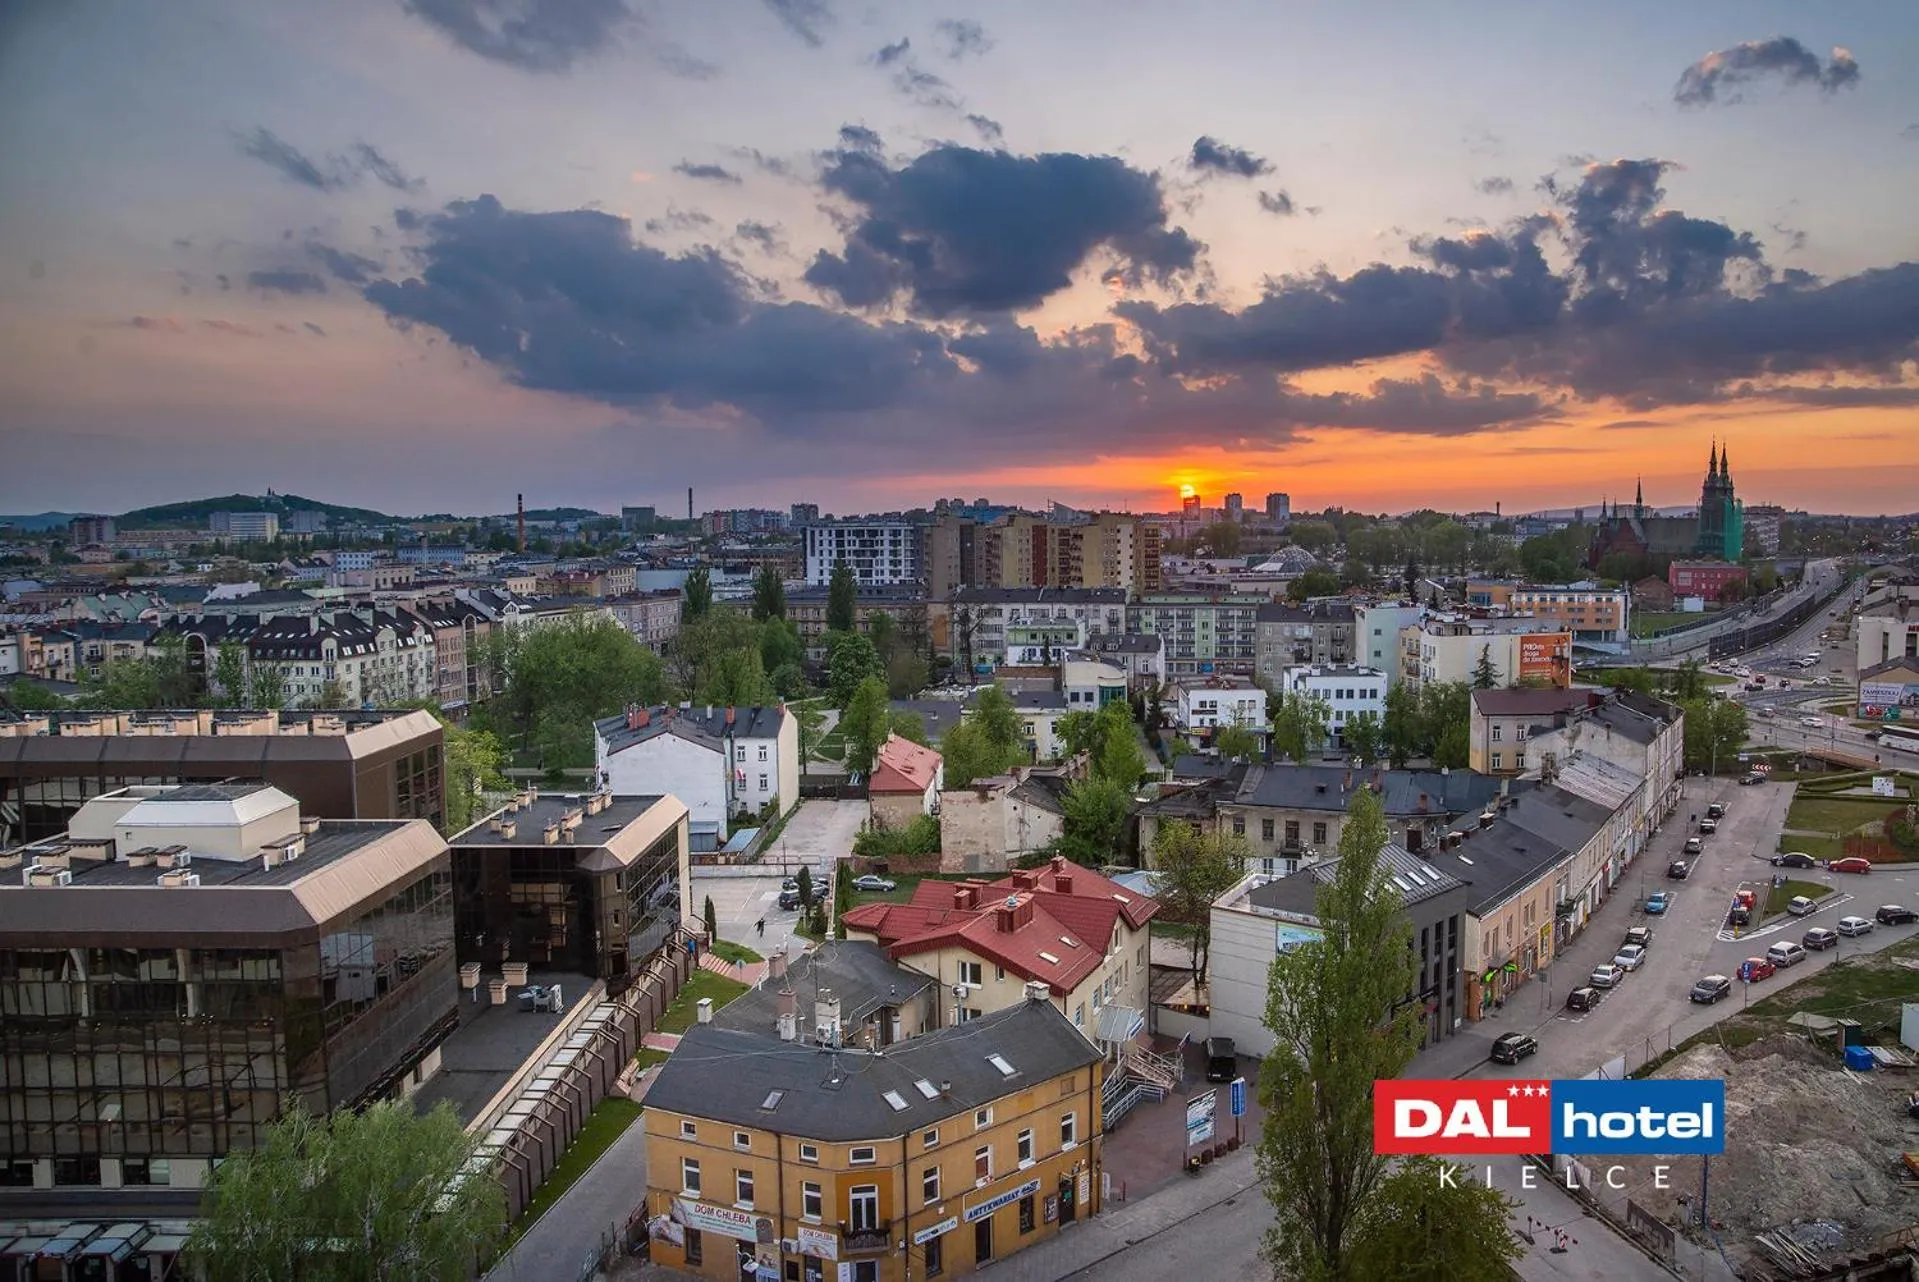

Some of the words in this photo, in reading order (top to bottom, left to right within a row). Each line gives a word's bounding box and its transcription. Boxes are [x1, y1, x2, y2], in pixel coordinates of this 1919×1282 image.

[694, 1204, 714, 1215] DOM
[716, 1208, 751, 1224] CHLEBA
[968, 1190, 1020, 1220] ANTYKWARIAT
